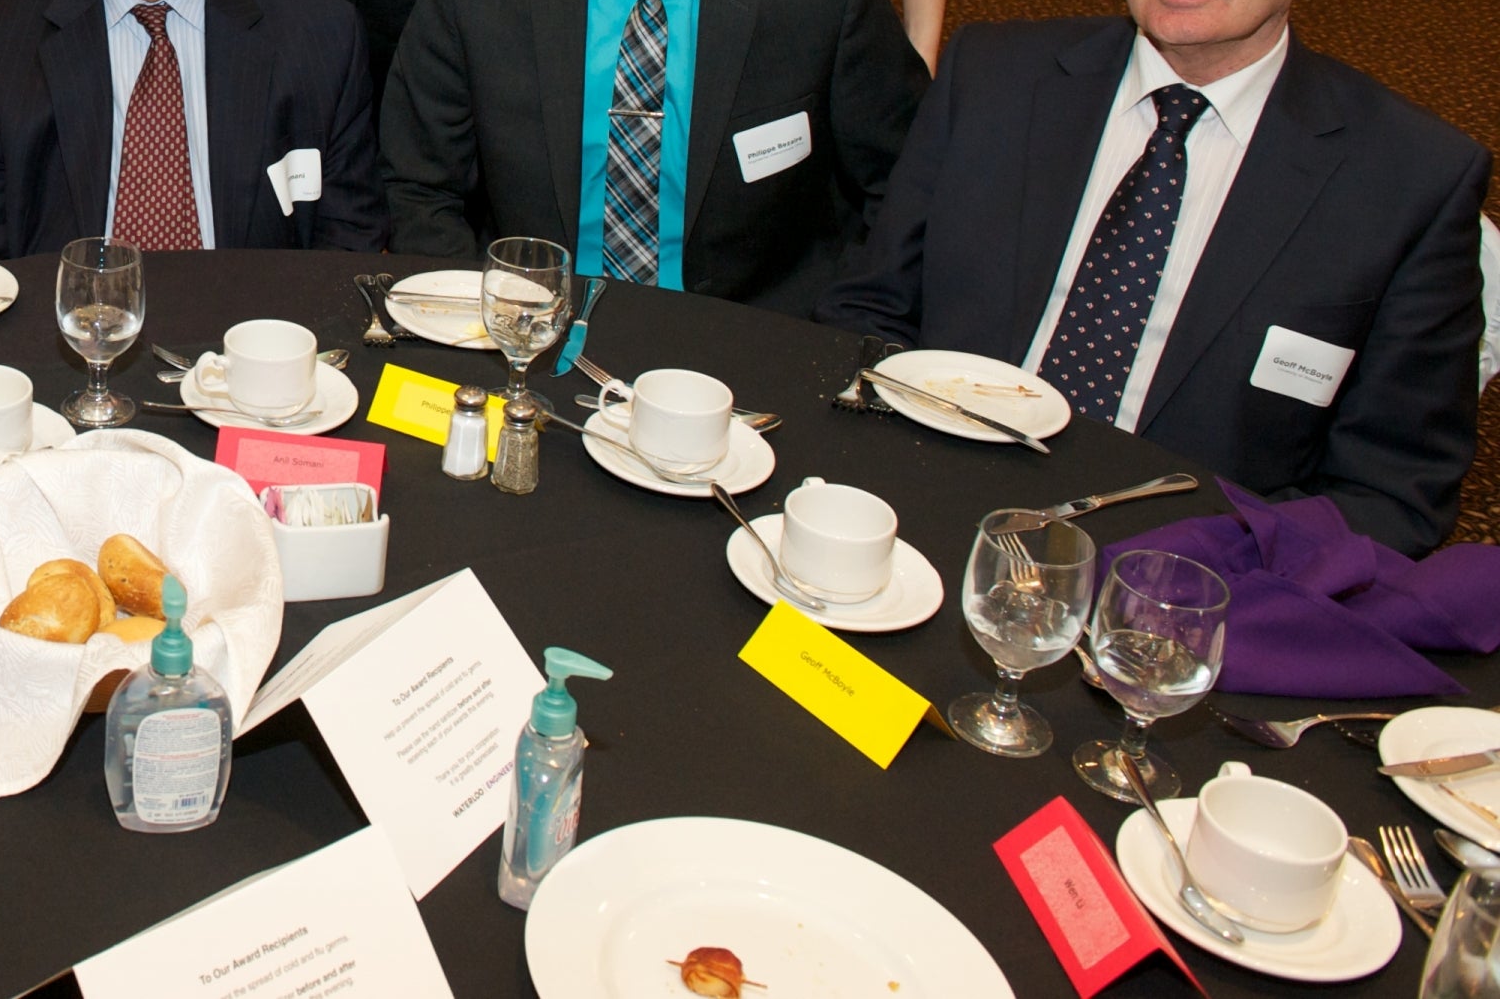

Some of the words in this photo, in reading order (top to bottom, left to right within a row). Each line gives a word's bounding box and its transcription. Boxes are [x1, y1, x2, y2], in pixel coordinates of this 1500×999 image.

[747, 145, 777, 160] Philippe
[777, 135, 803, 150] Bezaire
[1273, 357, 1298, 370] Geoff
[1298, 365, 1333, 382] McBoyle
[291, 457, 325, 468] Somani
[392, 697, 401, 707] To
[399, 689, 411, 700] Our
[411, 676, 427, 691] Award
[427, 656, 454, 680] Recipients
[800, 650, 823, 670] Geoff
[822, 668, 855, 697] McBoyle
[457, 694, 473, 708] before
[472, 687, 482, 696] and
[481, 678, 492, 689] after
[452, 789, 485, 817] WATERLOO
[486, 761, 514, 789] ENGINEER
[1064, 878, 1078, 900] Wen
[199, 973, 212, 985] To
[212, 963, 231, 978] Our
[232, 949, 260, 969] Award
[262, 925, 308, 955] Recipients
[248, 973, 274, 992] spread
[273, 967, 283, 977] of
[283, 959, 299, 972] cold
[300, 951, 314, 963] and
[296, 978, 321, 995] before
[322, 969, 337, 981] and
[338, 959, 356, 973] after
